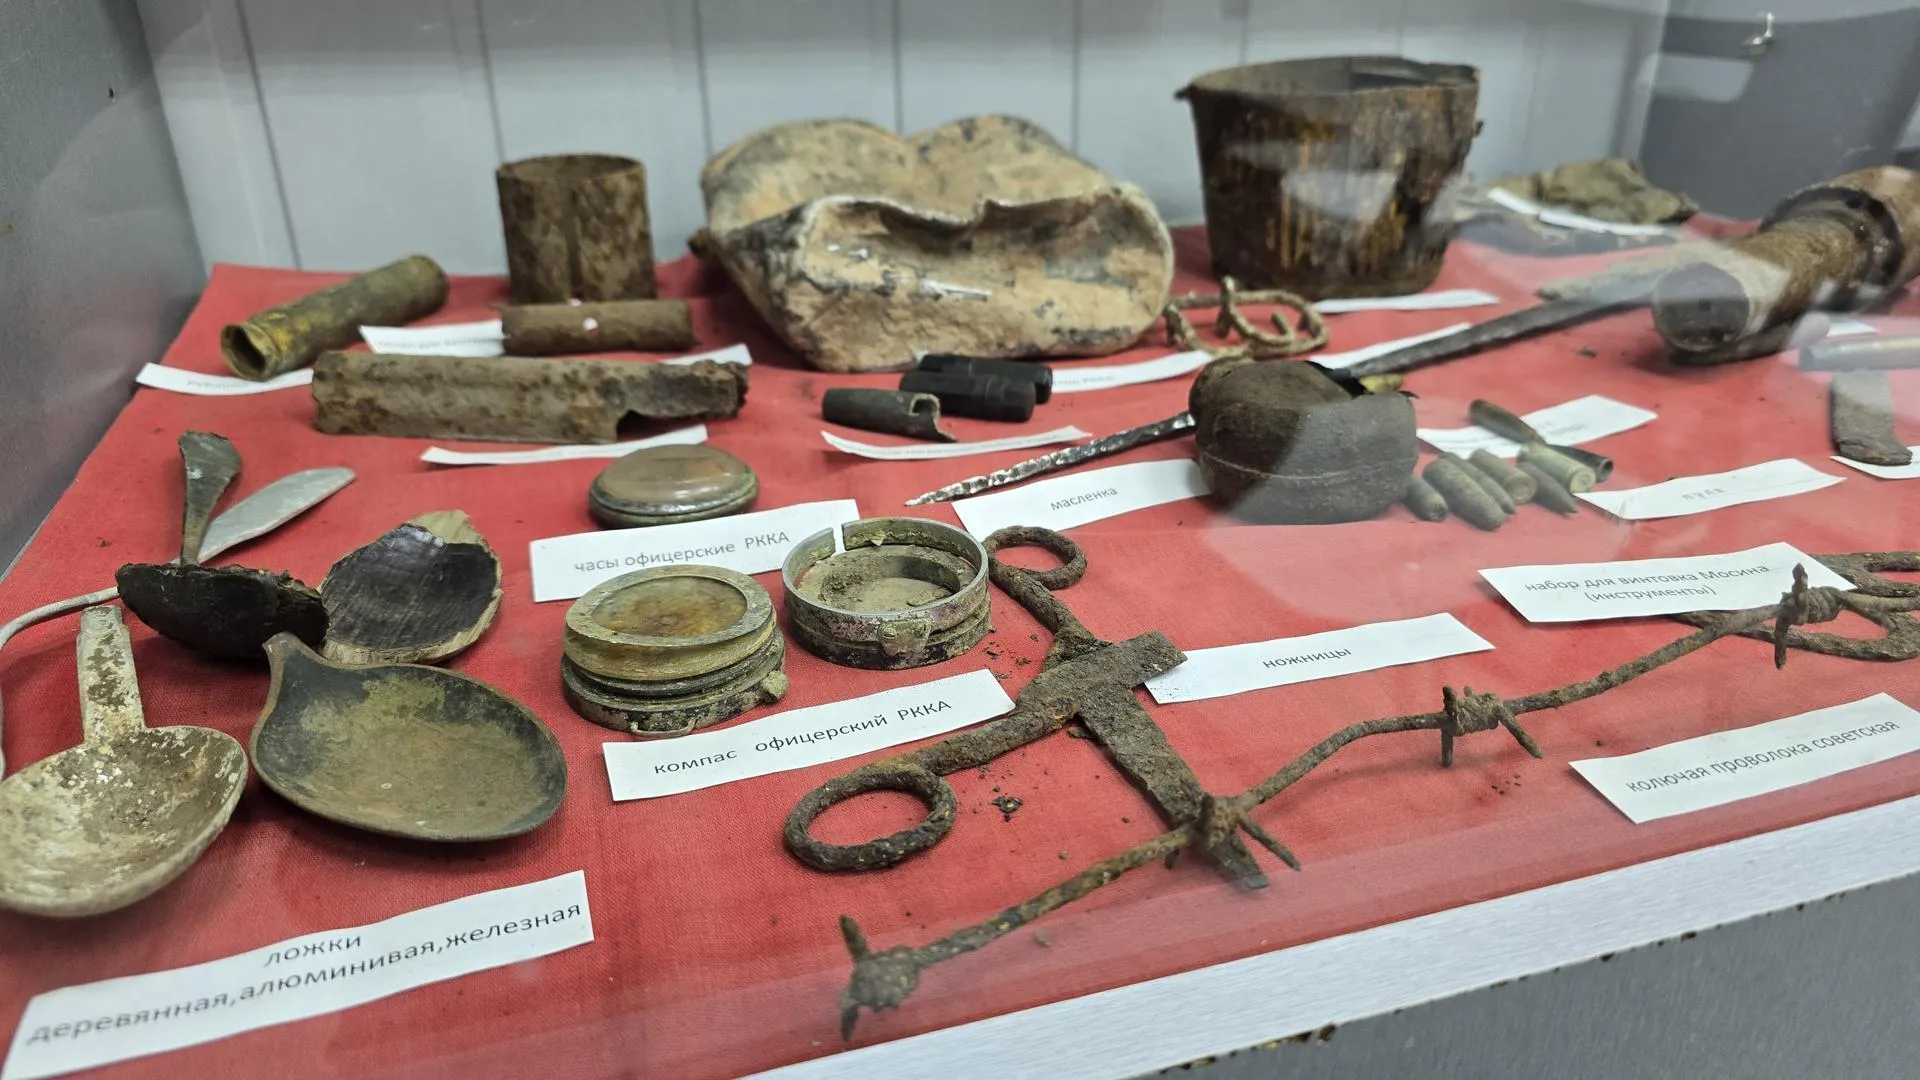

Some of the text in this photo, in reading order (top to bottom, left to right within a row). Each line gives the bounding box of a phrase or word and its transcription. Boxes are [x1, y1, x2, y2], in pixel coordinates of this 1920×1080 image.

[1050, 487, 1118, 511] масленка
[574, 531, 790, 573] часы офицерские РККА
[1524, 564, 1771, 592] набор для винтовка Мосина
[1584, 584, 1718, 602] (инструменты)
[1262, 648, 1352, 669] ножницы
[654, 700, 952, 774] компас офицерский РККА
[1625, 719, 1901, 793] колючая проволока советская
[263, 934, 362, 968] ложки
